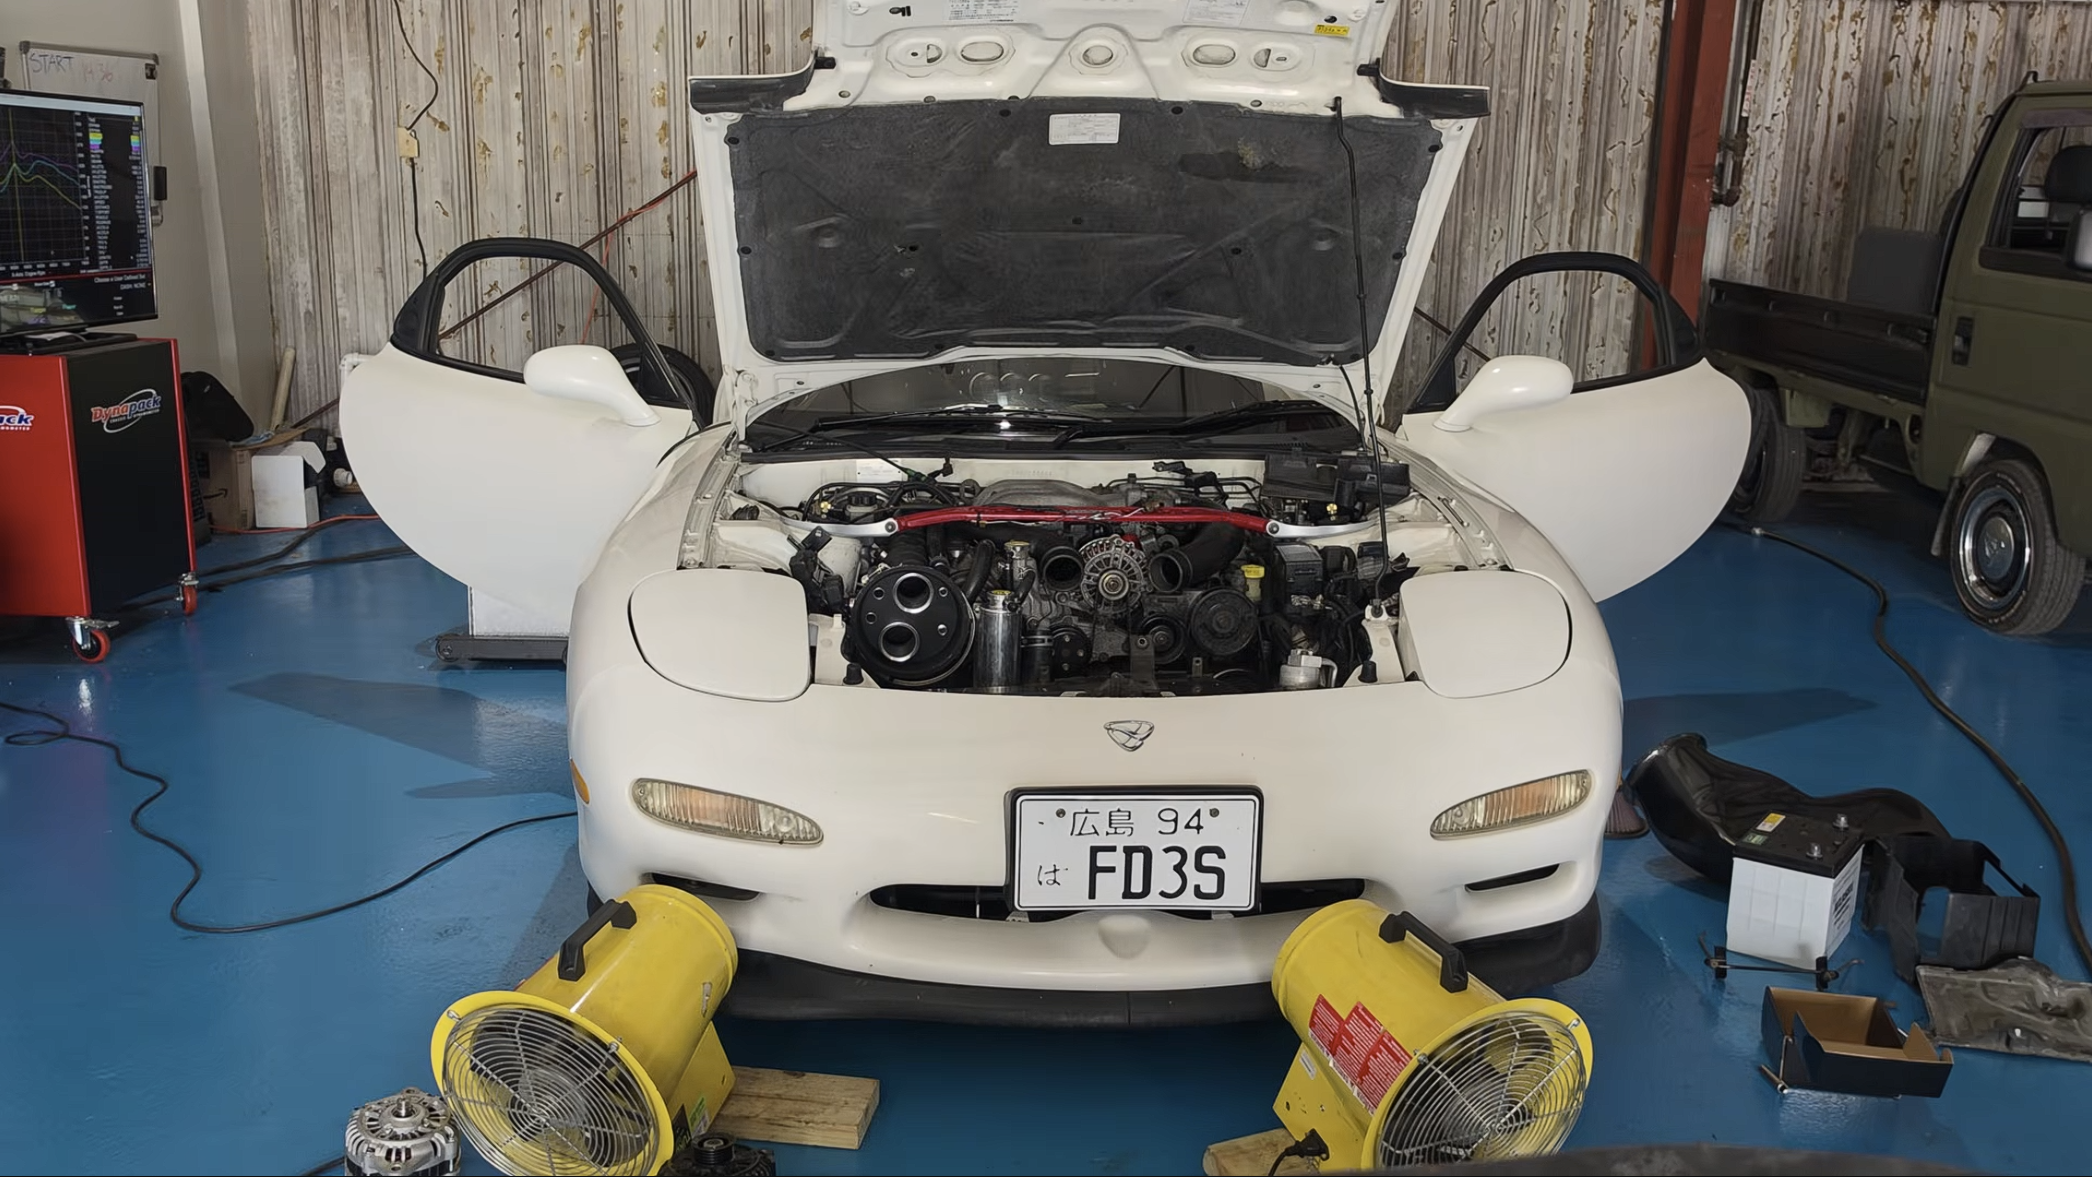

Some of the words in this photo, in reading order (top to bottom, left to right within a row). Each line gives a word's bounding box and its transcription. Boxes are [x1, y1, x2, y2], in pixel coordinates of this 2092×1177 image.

[29, 52, 74, 75] START
[90, 395, 162, 423] Dynapack
[1070, 808, 1135, 838] 広島
[1157, 807, 1205, 836] 94
[1088, 845, 1227, 900] FD3S
